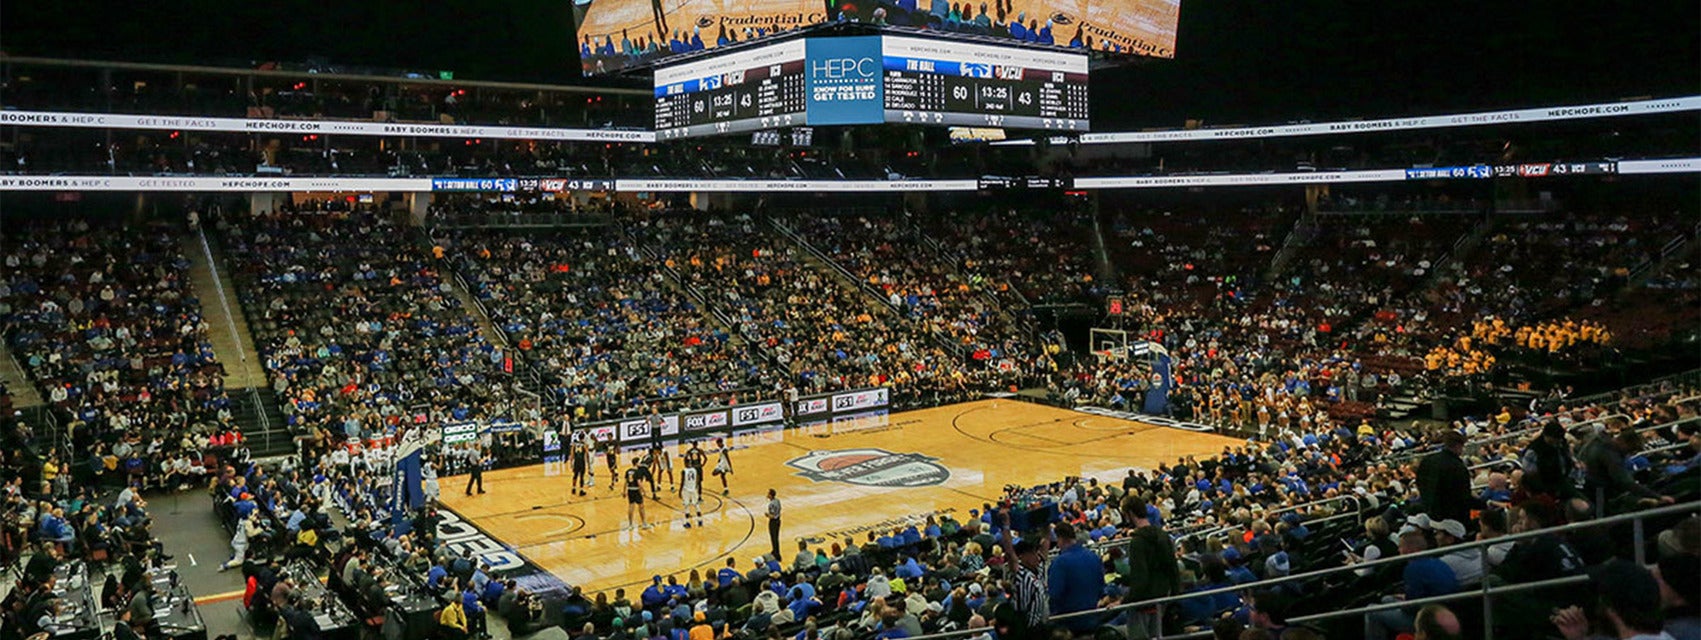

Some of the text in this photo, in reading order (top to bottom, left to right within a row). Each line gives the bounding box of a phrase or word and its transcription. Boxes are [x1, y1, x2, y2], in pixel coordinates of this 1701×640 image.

[720, 13, 803, 25] Prudential
[1079, 20, 1156, 54] Prudential
[1001, 66, 1021, 80] VCU
[813, 91, 876, 102] GET TESTED
[953, 86, 968, 100] 60
[982, 86, 1008, 99] 13:25
[1018, 92, 1032, 105] 43
[694, 100, 705, 113] 60
[740, 93, 752, 108] 43
[1, 113, 57, 122] BOOMERS
[137, 118, 157, 126] GET
[162, 119, 182, 127] THE
[186, 119, 217, 127] FACTS
[246, 122, 320, 130] HEPCHOPE.COM
[1214, 128, 1274, 137] HEPCHOPE.COM
[1354, 122, 1392, 130] BOOMERS
[1491, 113, 1519, 121] FACTS
[1548, 105, 1629, 117] HEPCHOPE.COM
[1453, 169, 1464, 177] 60
[1525, 165, 1547, 175] VCU
[1553, 164, 1566, 173] 43
[19, 179, 68, 187] BOOMERS
[481, 181, 492, 190] 60
[547, 180, 564, 190] VCU
[568, 181, 579, 189] 43
[741, 411, 758, 421] FS1
[686, 417, 704, 429] FOX
[630, 423, 649, 436] FS1
